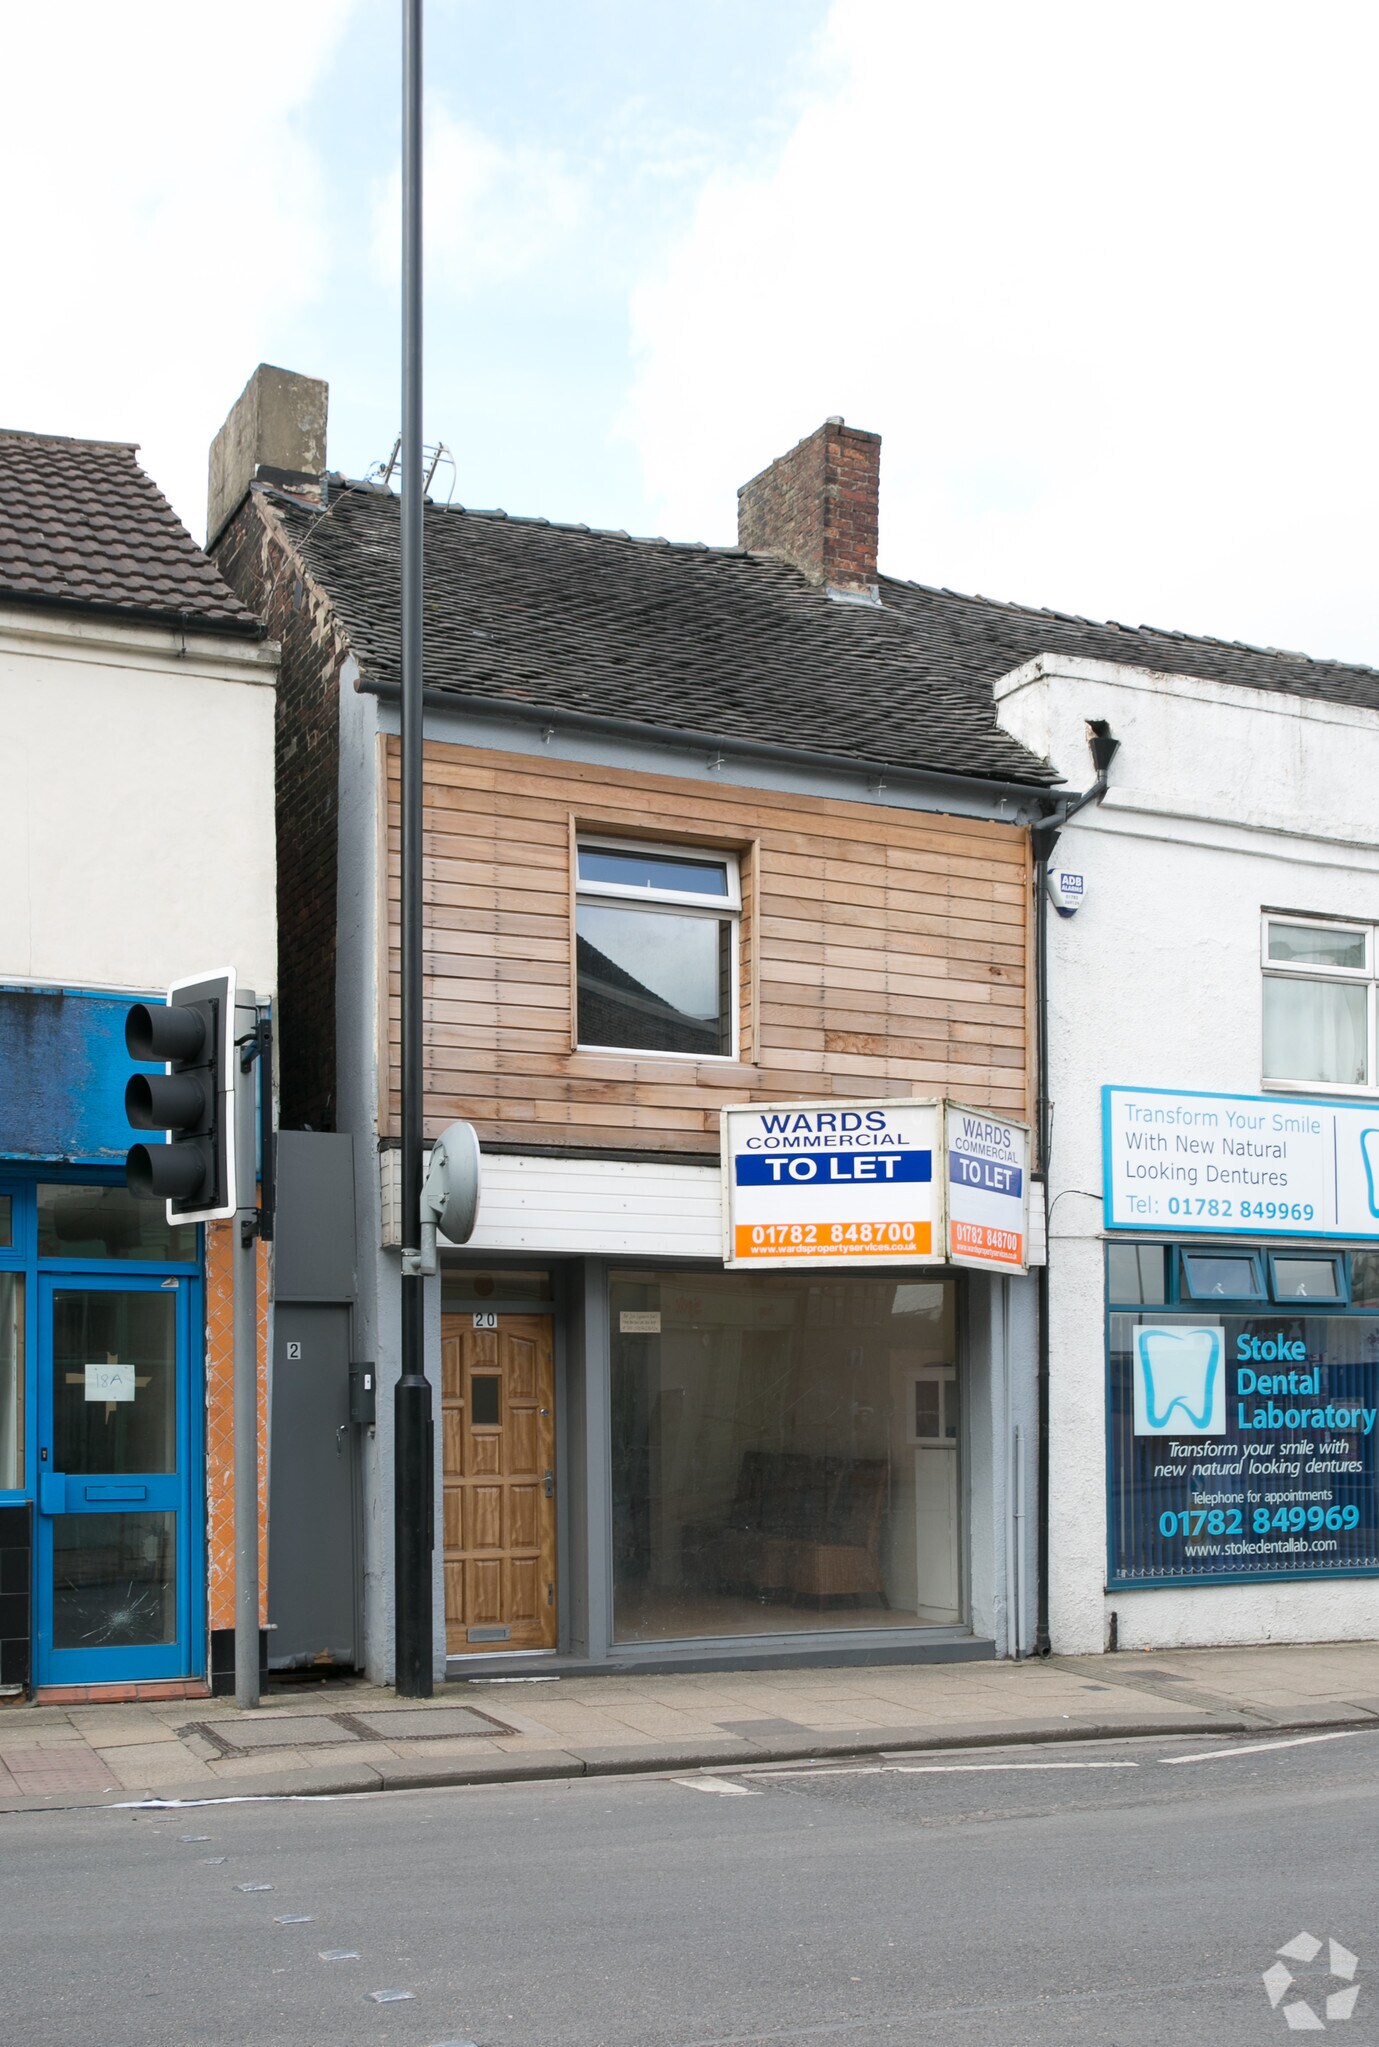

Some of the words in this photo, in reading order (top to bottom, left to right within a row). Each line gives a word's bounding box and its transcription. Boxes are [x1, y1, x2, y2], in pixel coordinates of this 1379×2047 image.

[1062, 875, 1082, 887] ADB
[760, 1110, 887, 1134] WARDS
[1124, 1103, 1219, 1127] Transform
[1226, 1110, 1266, 1130] Your
[1272, 1113, 1321, 1135] Smile
[746, 1133, 911, 1150] COMMERCIAL
[962, 1117, 1012, 1149] WARDS
[1125, 1131, 1168, 1151] With
[1176, 1135, 1215, 1155] New
[1222, 1137, 1287, 1159] Natural
[955, 1137, 1019, 1164] COMMERCIAL
[765, 1157, 818, 1181] TO
[829, 1155, 902, 1180] LET
[959, 1158, 981, 1184] TO
[985, 1164, 1013, 1191] LET
[1126, 1160, 1198, 1186] Looking
[1206, 1164, 1288, 1187] Dentures
[1126, 1195, 1160, 1214] Tel:
[1168, 1196, 1233, 1217] 01782
[1240, 1200, 1314, 1221] 849969
[751, 1225, 818, 1244] 01782
[830, 1222, 916, 1243] 848700
[956, 1223, 983, 1245] 01782
[986, 1229, 1017, 1251] 848700
[750, 1242, 918, 1255] www.wardspropertyservices.co.uk
[475, 1312, 495, 1327] 20
[290, 1343, 299, 1358] 2
[1236, 1332, 1307, 1362] Stoke
[1237, 1366, 1320, 1396] Dental
[1237, 1401, 1378, 1436] Laboratory
[1168, 1440, 1238, 1458] Transform
[1242, 1442, 1275, 1460] your
[1279, 1439, 1314, 1456] smile
[1319, 1438, 1350, 1455] with
[1154, 1464, 1187, 1477] new
[1192, 1459, 1244, 1476] natural
[1249, 1458, 1301, 1478] looking
[1305, 1457, 1363, 1474] dentures
[1192, 1490, 1244, 1507] Telephone
[1247, 1489, 1262, 1503] for
[1264, 1488, 1333, 1505] appointments
[1158, 1508, 1243, 1539] 01782
[1252, 1504, 1360, 1534] 849969
[1184, 1537, 1337, 1557] www.stokedentallab.com
